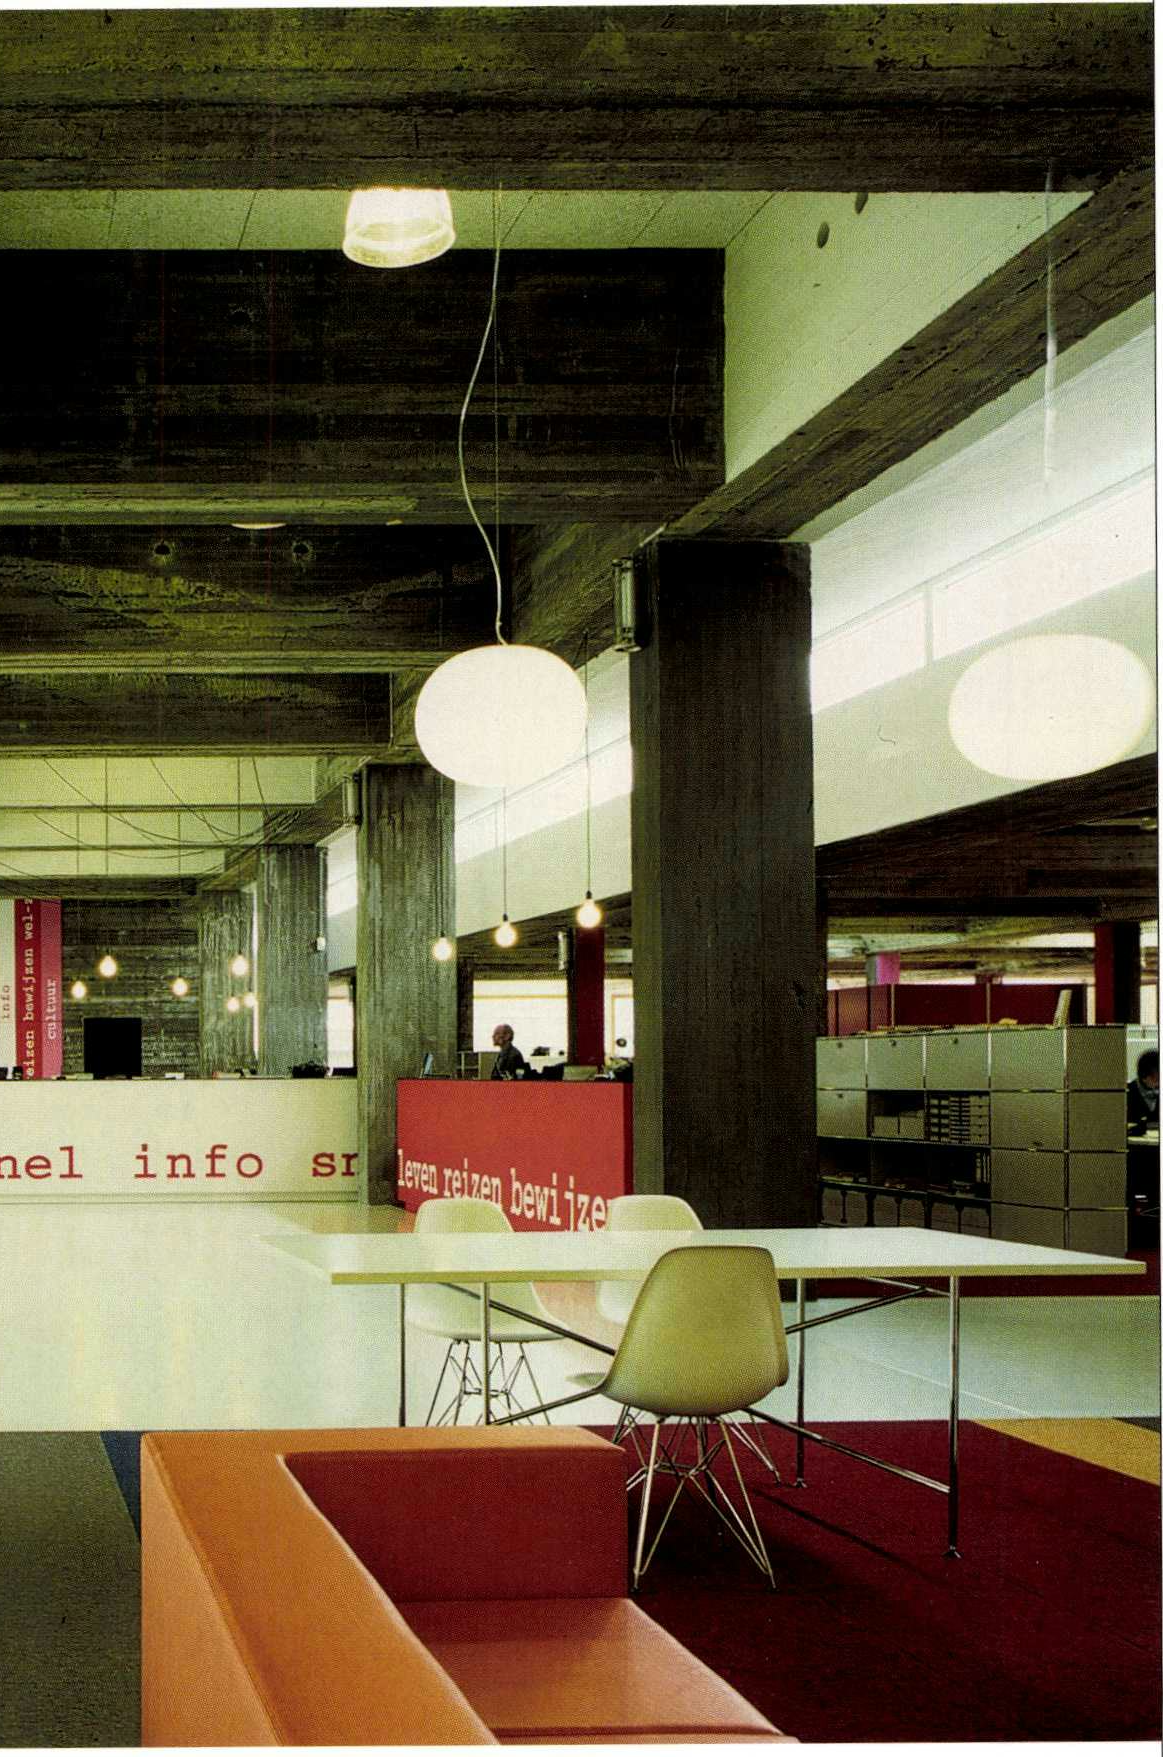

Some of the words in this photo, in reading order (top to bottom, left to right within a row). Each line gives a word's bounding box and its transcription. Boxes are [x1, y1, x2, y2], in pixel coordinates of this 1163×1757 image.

[1, 985, 10, 1019] info
[23, 948, 35, 1021] bewijzen
[45, 978, 56, 1040] cultuur
[23, 1030, 35, 1080] eizen
[134, 1143, 263, 1179] info
[398, 1148, 438, 1195] leven
[443, 1158, 502, 1207] reizen
[510, 1167, 612, 1232] bewijze
